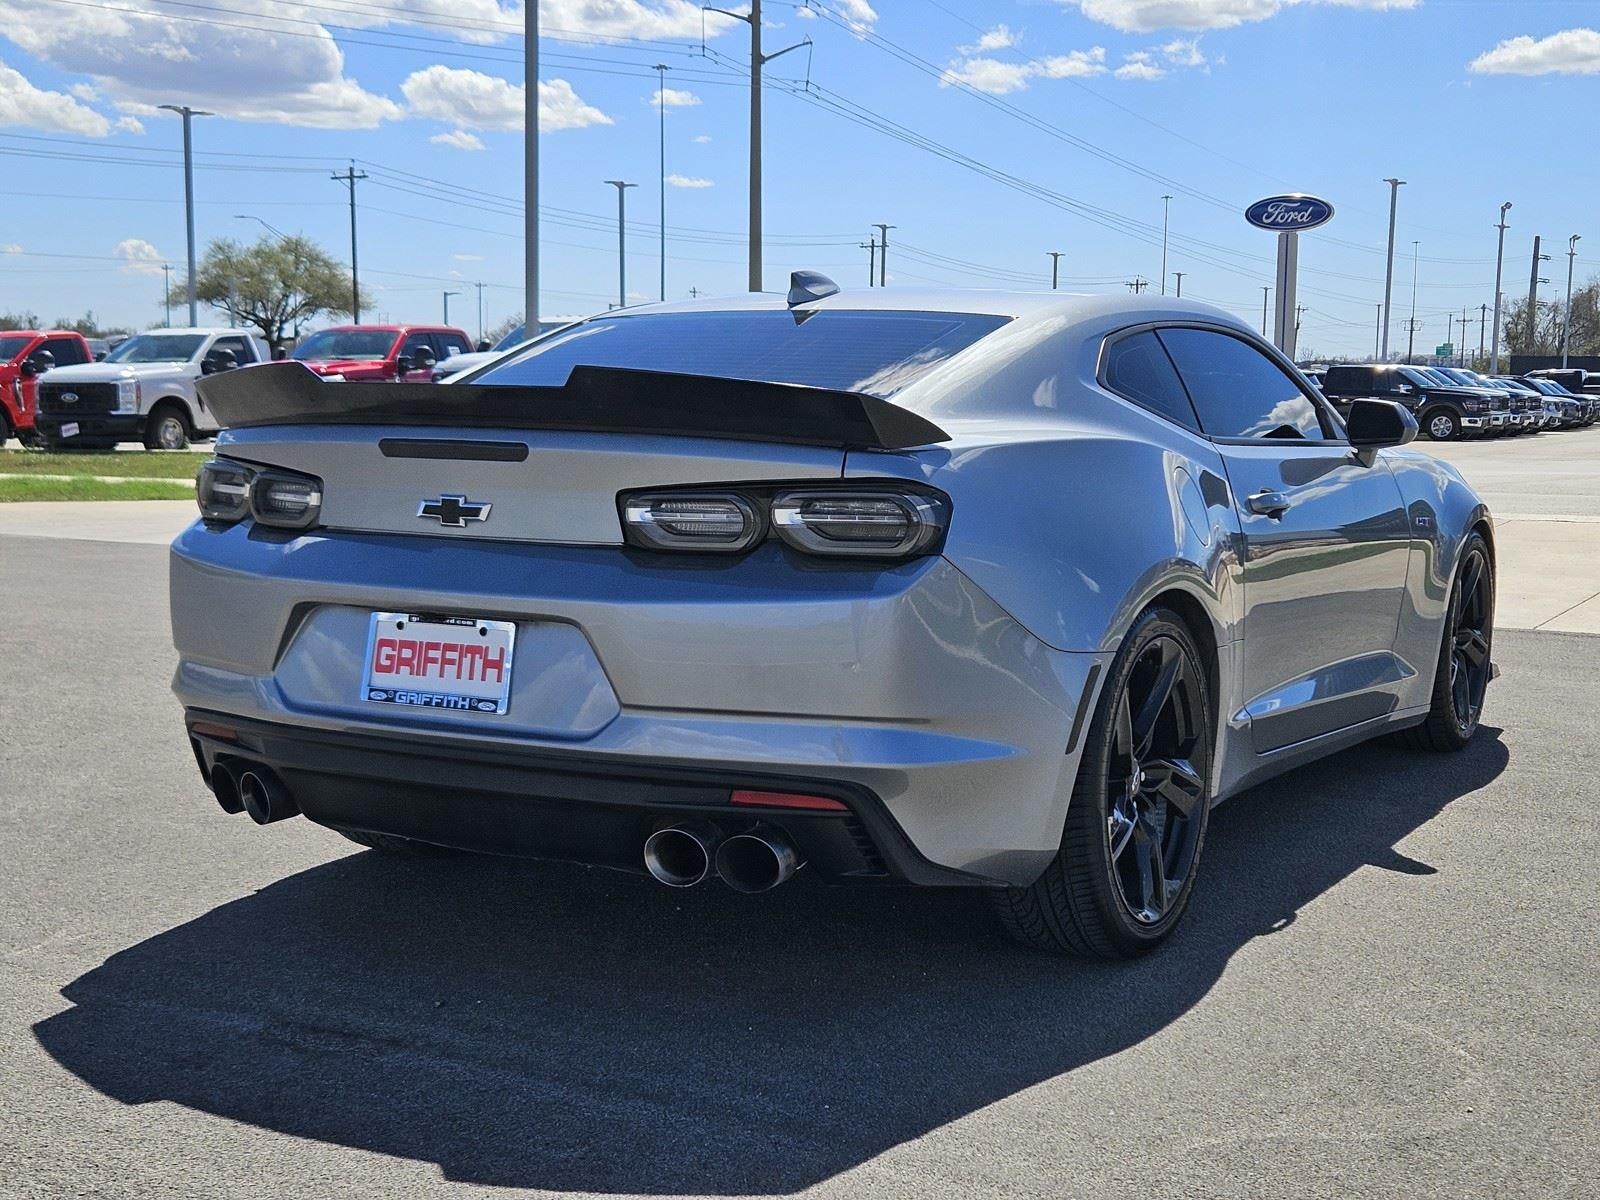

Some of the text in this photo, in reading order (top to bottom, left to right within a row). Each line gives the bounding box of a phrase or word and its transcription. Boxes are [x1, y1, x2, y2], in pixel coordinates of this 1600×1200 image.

[1262, 201, 1314, 224] Ford
[374, 638, 505, 683] GRIFFITH
[395, 691, 470, 710] GRIFFITH
